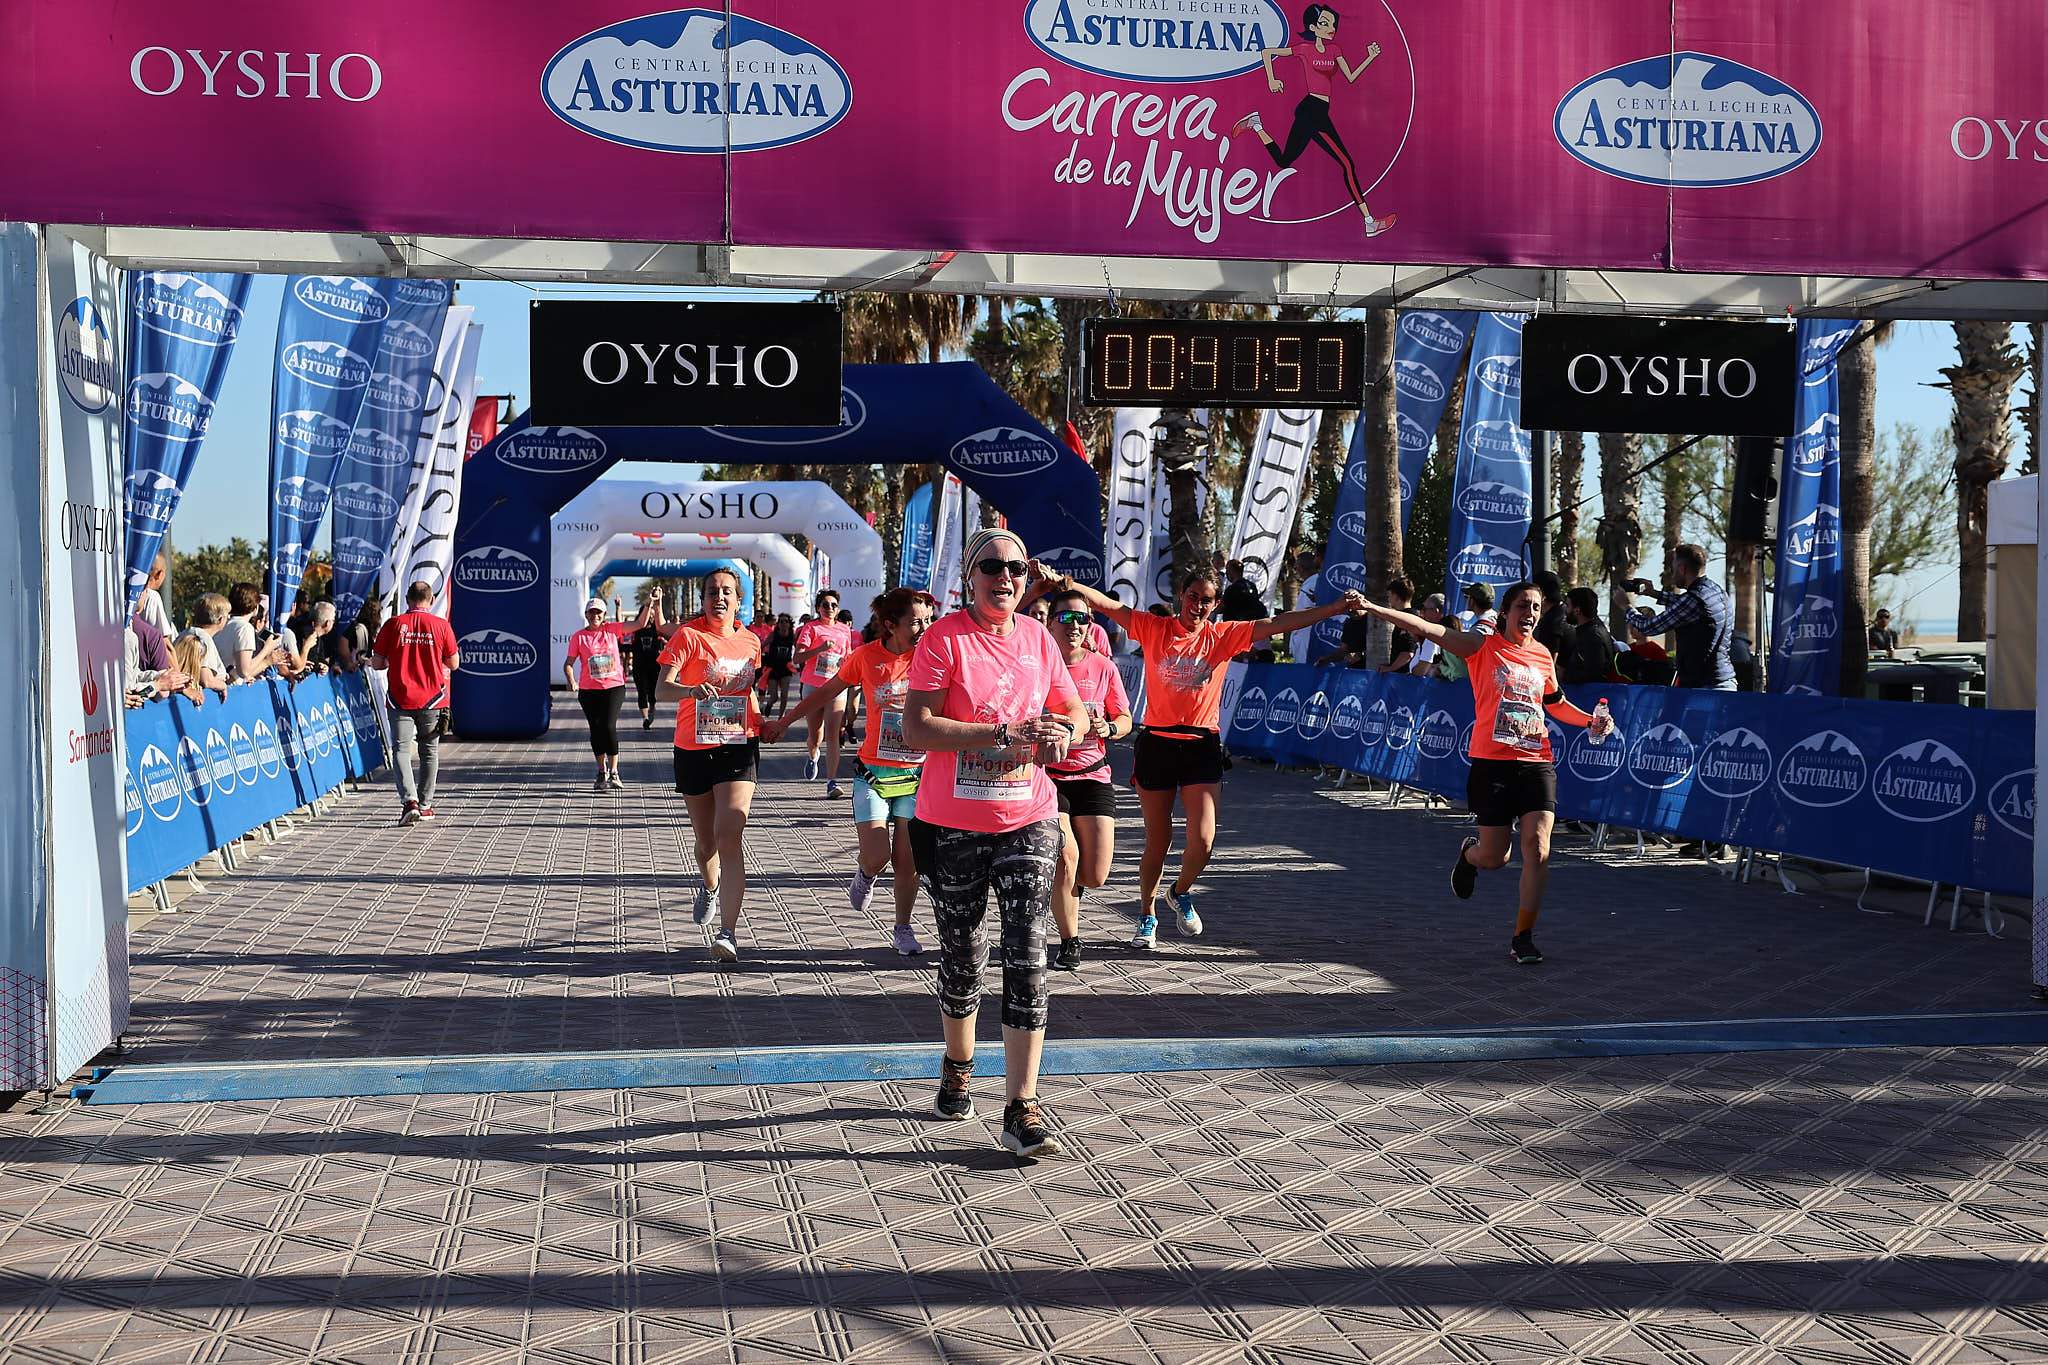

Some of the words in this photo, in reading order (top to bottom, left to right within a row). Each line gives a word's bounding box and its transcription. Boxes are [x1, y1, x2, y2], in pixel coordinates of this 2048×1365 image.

[1178, 1, 1260, 15] LECHERA
[1045, 0, 1267, 52] ASTURIANA
[130, 45, 383, 103] OYSHO
[614, 57, 711, 73] CENTRAL
[566, 58, 829, 117] ASTURIANA
[1001, 67, 1218, 140] Carrera
[1617, 97, 1700, 112] CENTRAL
[1709, 100, 1793, 115] LECHERA
[1575, 98, 1801, 154] ASTURIANA
[1054, 138, 1094, 185] de
[1103, 138, 1132, 187] la
[1126, 137, 1297, 244] Mujer
[136, 290, 237, 338] ASTURIANA
[300, 282, 383, 318] ASTURIANA
[382, 334, 427, 354] TURIANA
[1405, 317, 1460, 351] ASTURIANA
[62, 328, 112, 392] ASTURIANA
[286, 350, 366, 384] ASTURIANA
[582, 341, 799, 388] OYSHO
[1104, 334, 1344, 392] 00:41:57
[1396, 372, 1439, 399] STURIANA
[1481, 363, 1520, 389] ASTUR
[1567, 353, 1757, 399] OYSHO
[129, 387, 211, 433] ATURIANA
[369, 387, 416, 409] TURIANA
[350, 442, 402, 463] STURIANA
[502, 440, 598, 461] ASTURIANA
[959, 447, 1052, 466] ASTURIANA
[334, 490, 393, 516] ASTURIANA
[640, 491, 779, 520] OYSHO
[61, 500, 116, 555] OYSHO
[556, 522, 599, 532] OYSHO
[817, 521, 858, 531] OYSHO
[457, 563, 534, 582] ASTURIANA
[551, 578, 578, 588] SHO
[838, 578, 877, 588] OYSHO
[68, 722, 114, 764] Santander
[1571, 749, 1620, 768] ASTURIANA
[1631, 748, 1687, 774] ASTURIANA
[1701, 749, 1764, 781] ASTURIANA
[1782, 756, 1858, 791] ASTURIANA
[963, 787, 990, 796] OYSHO
[1878, 765, 1963, 805] ASTURIANA
